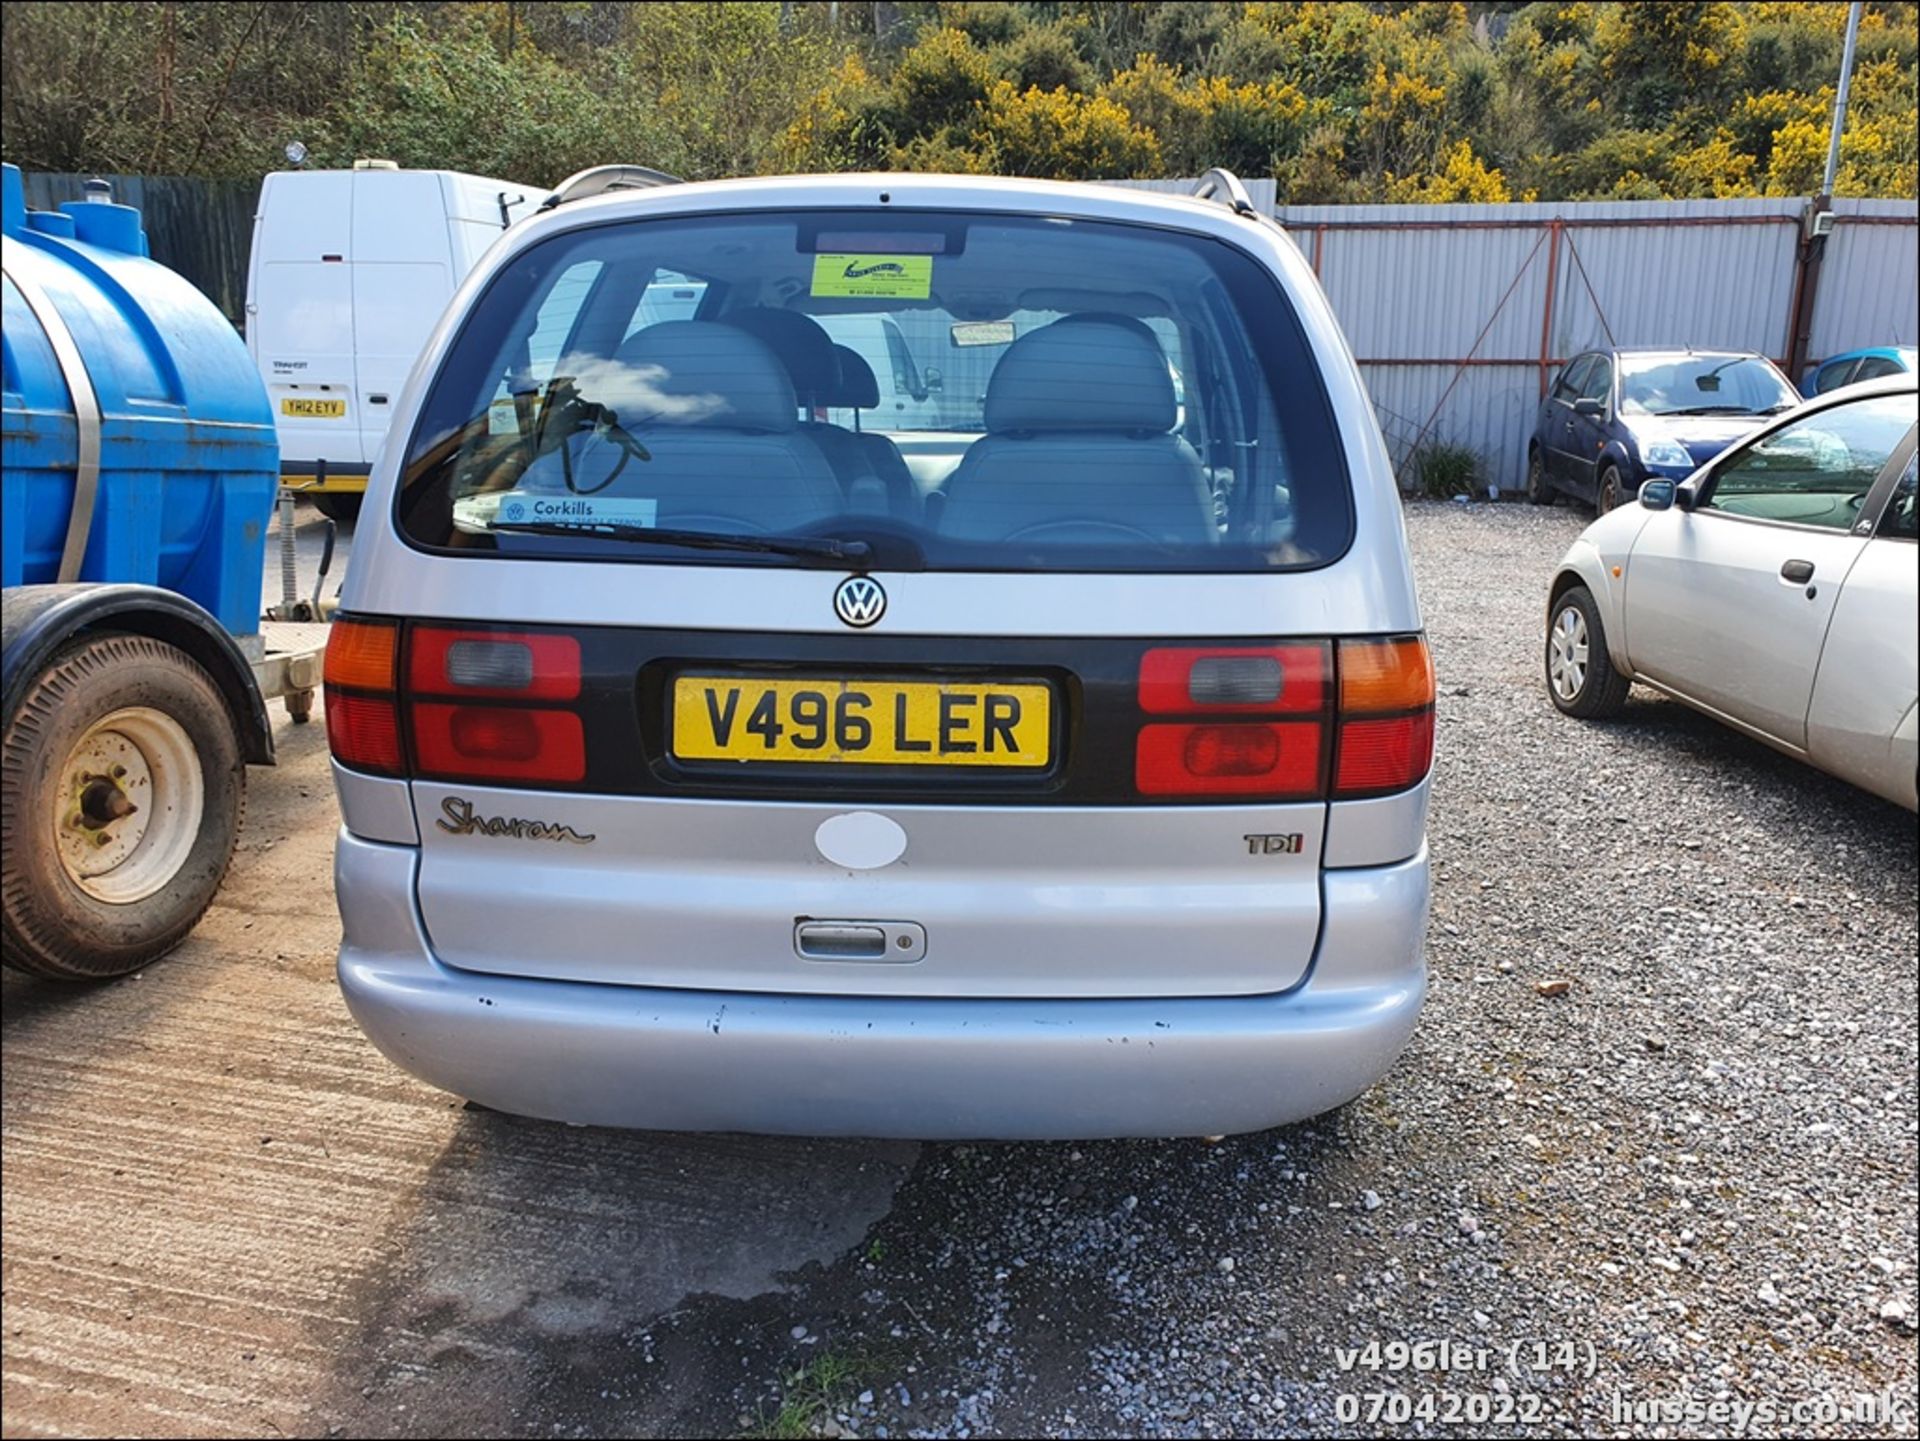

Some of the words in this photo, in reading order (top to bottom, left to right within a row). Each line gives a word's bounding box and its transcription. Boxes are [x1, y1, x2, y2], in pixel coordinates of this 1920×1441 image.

[316, 400, 338, 414] EYV
[534, 501, 593, 515] Corkills
[704, 688, 872, 751] V496
[894, 692, 1021, 753] LER
[436, 796, 596, 844] Sharan
[1243, 832, 1303, 854] TDI
